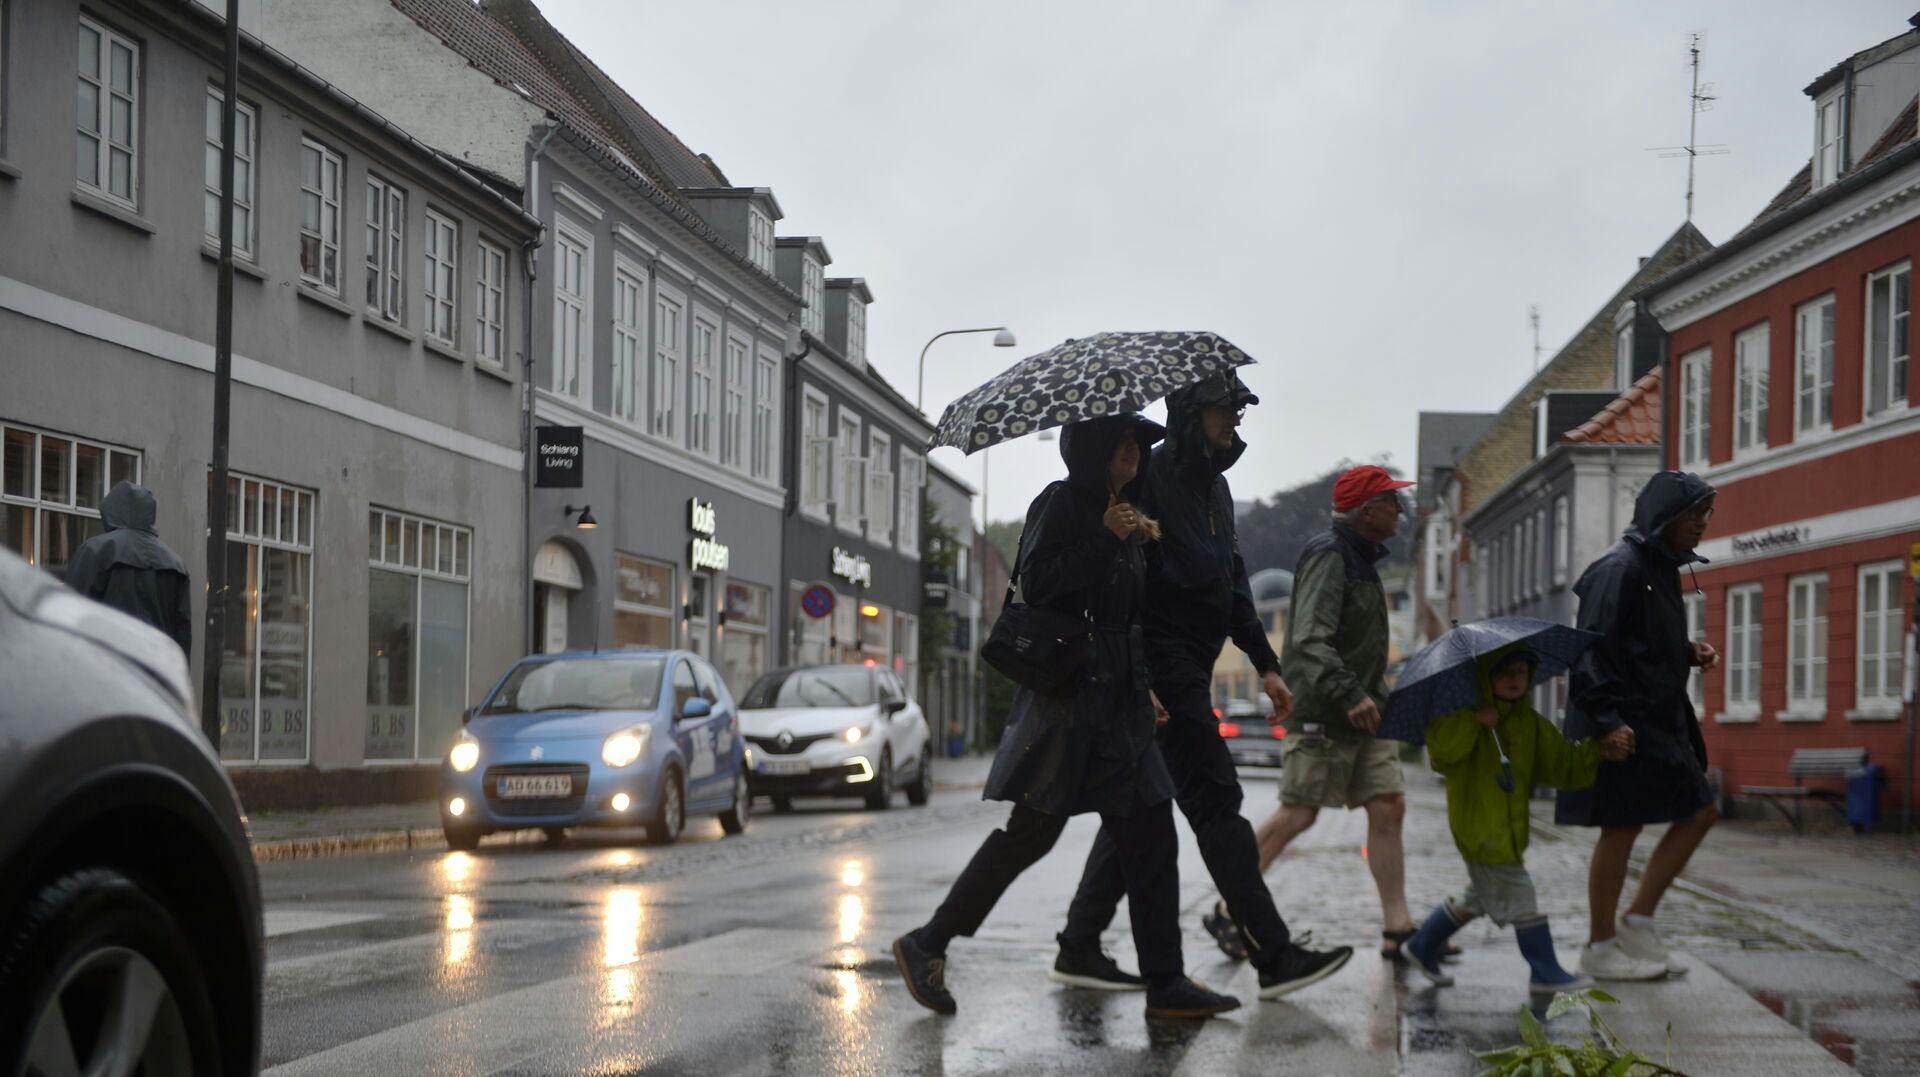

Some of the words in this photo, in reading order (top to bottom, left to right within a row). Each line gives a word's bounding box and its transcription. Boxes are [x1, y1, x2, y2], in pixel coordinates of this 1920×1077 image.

[541, 443, 579, 457] Schiang
[545, 457, 574, 470] Living
[691, 496, 716, 535] louis
[691, 535, 730, 572] poulsen
